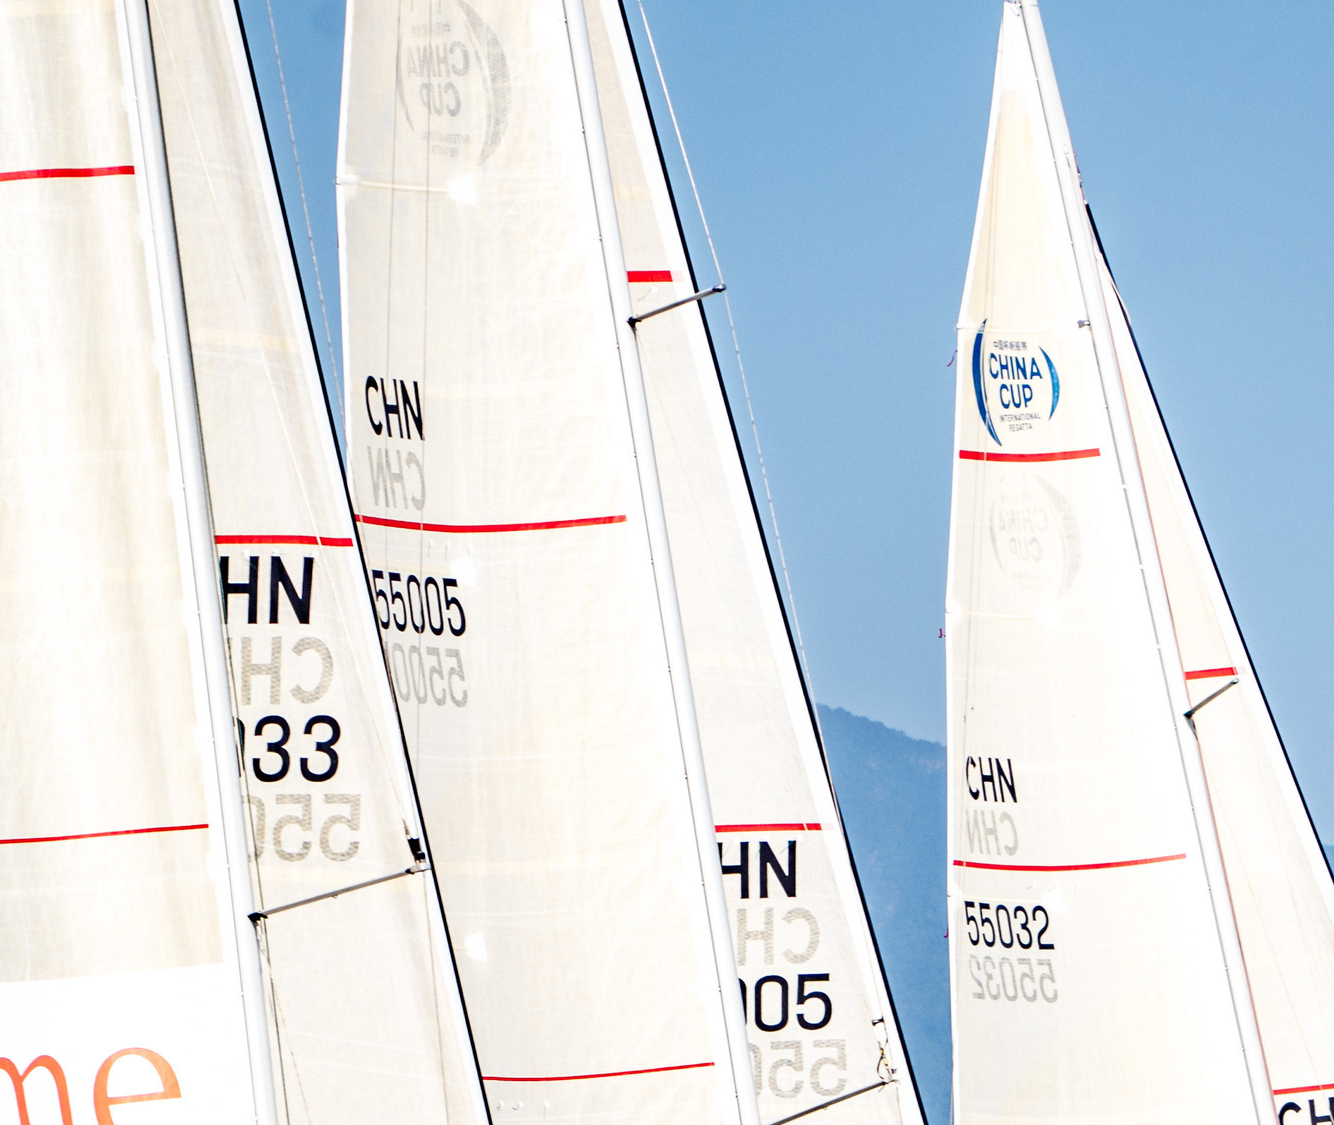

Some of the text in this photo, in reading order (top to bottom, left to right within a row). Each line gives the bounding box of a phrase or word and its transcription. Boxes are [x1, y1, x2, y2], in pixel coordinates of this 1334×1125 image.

[989, 353, 1043, 380] CHINA
[365, 375, 425, 441] CHN
[1000, 384, 1033, 409] CUP
[219, 556, 314, 624] HN
[371, 568, 466, 637] 55005
[234, 715, 341, 782] 33
[966, 756, 1017, 803] CHN
[717, 840, 797, 899] HN
[964, 901, 1055, 950] 55032
[737, 973, 833, 1032] 05
